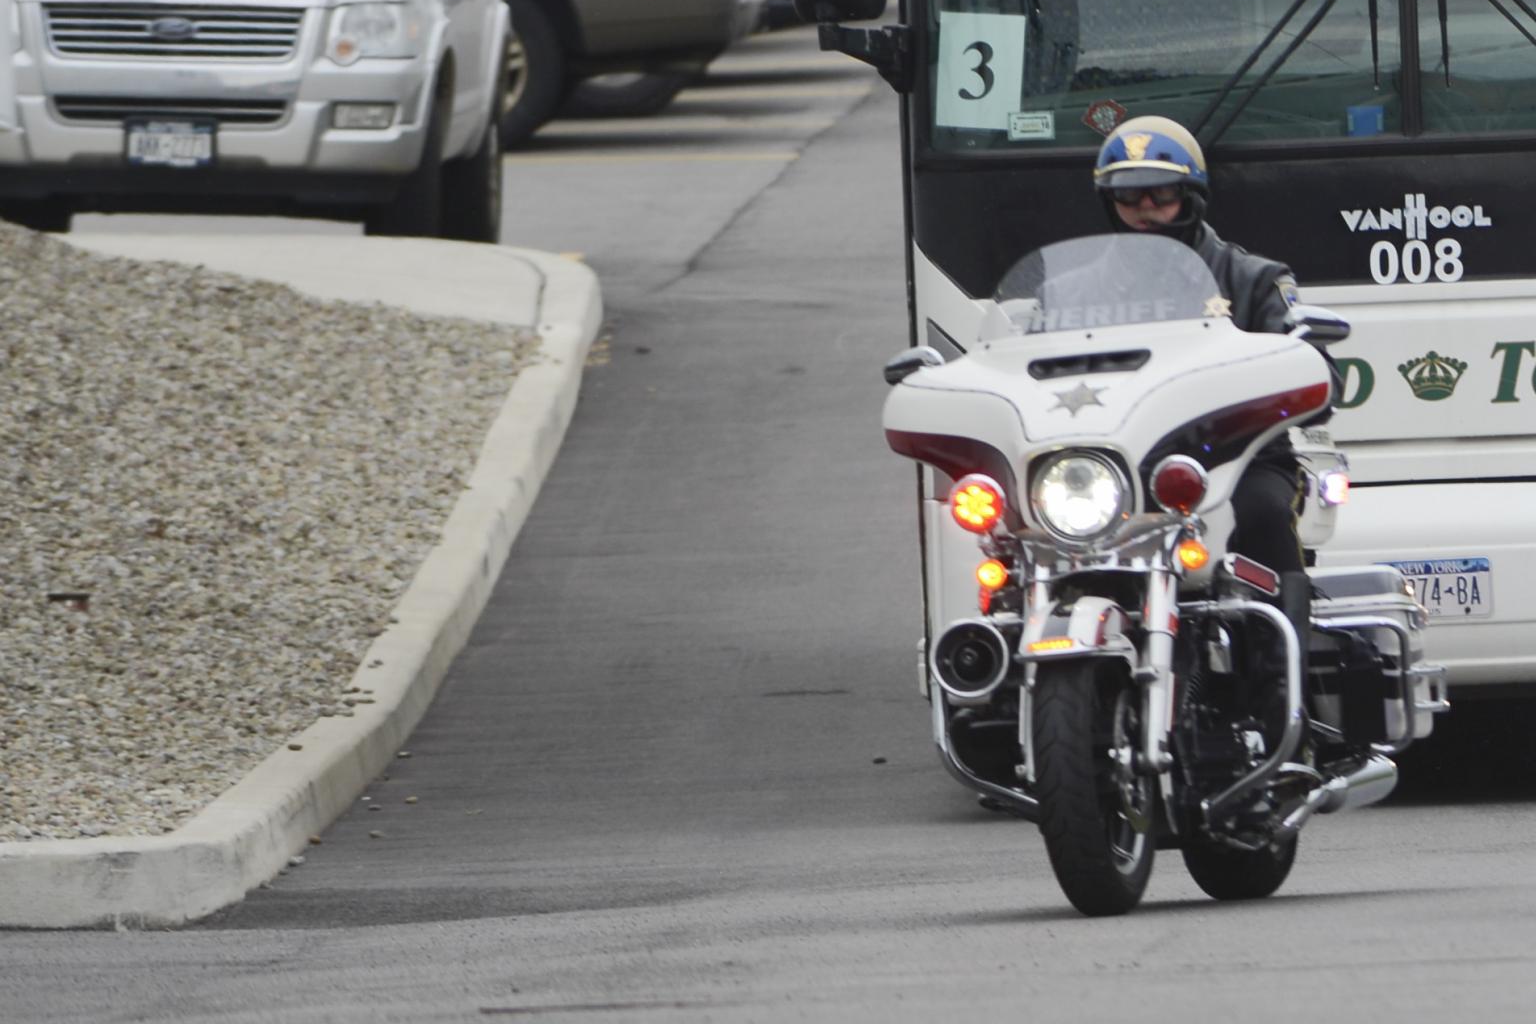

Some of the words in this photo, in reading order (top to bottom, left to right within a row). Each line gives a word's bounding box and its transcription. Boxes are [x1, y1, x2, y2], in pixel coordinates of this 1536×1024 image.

[958, 41, 994, 100] 3
[1369, 238, 1463, 285] 008
[1022, 297, 1177, 332] HERIFF
[1428, 560, 1462, 574] YORK
